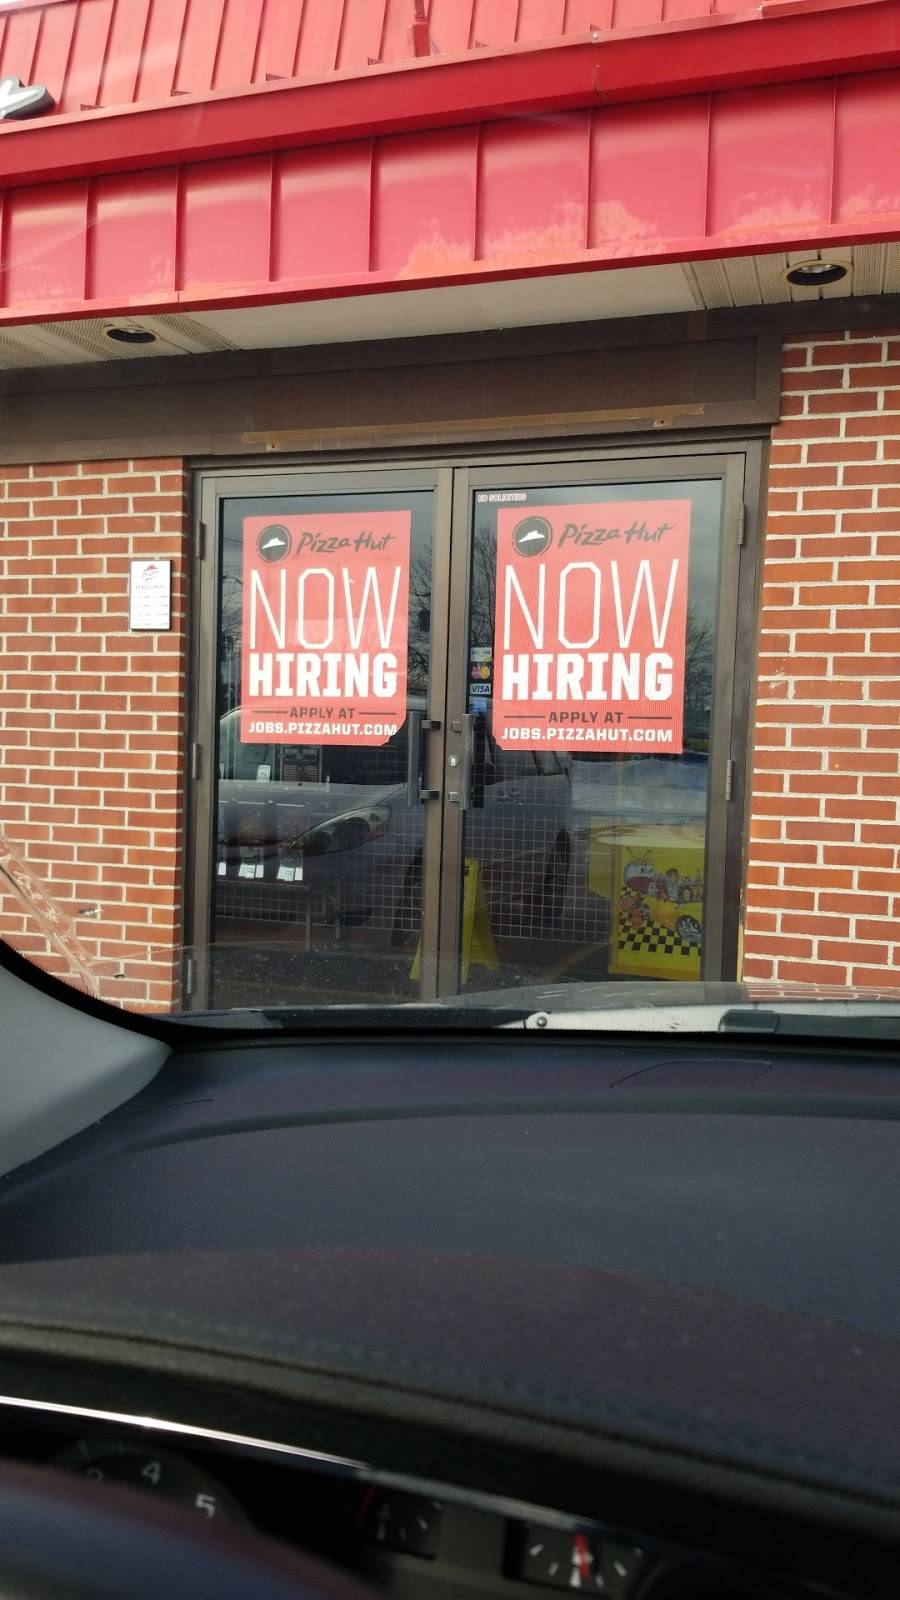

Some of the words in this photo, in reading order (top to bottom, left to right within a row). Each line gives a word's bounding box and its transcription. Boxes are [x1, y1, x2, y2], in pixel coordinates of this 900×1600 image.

[296, 532, 351, 555] Pizza
[354, 531, 396, 551] Hut
[558, 522, 622, 548] Pizza
[624, 520, 675, 544] Hut
[249, 566, 402, 650] NOW
[503, 558, 680, 650] NOW
[249, 652, 398, 698] HIRING
[502, 652, 674, 701] HIRING
[472, 685, 490, 693] VISA
[289, 707, 334, 719] APPLY
[338, 708, 356, 719] AT
[548, 711, 599, 724] APPLY
[604, 712, 624, 724] AT
[248, 721, 398, 736] JOBS.PIZZAHUT.COM
[501, 727, 673, 742] JOBS.PIZZAHUT.COM
[141, 1461, 161, 1484] 4
[195, 1493, 217, 1519] 5
